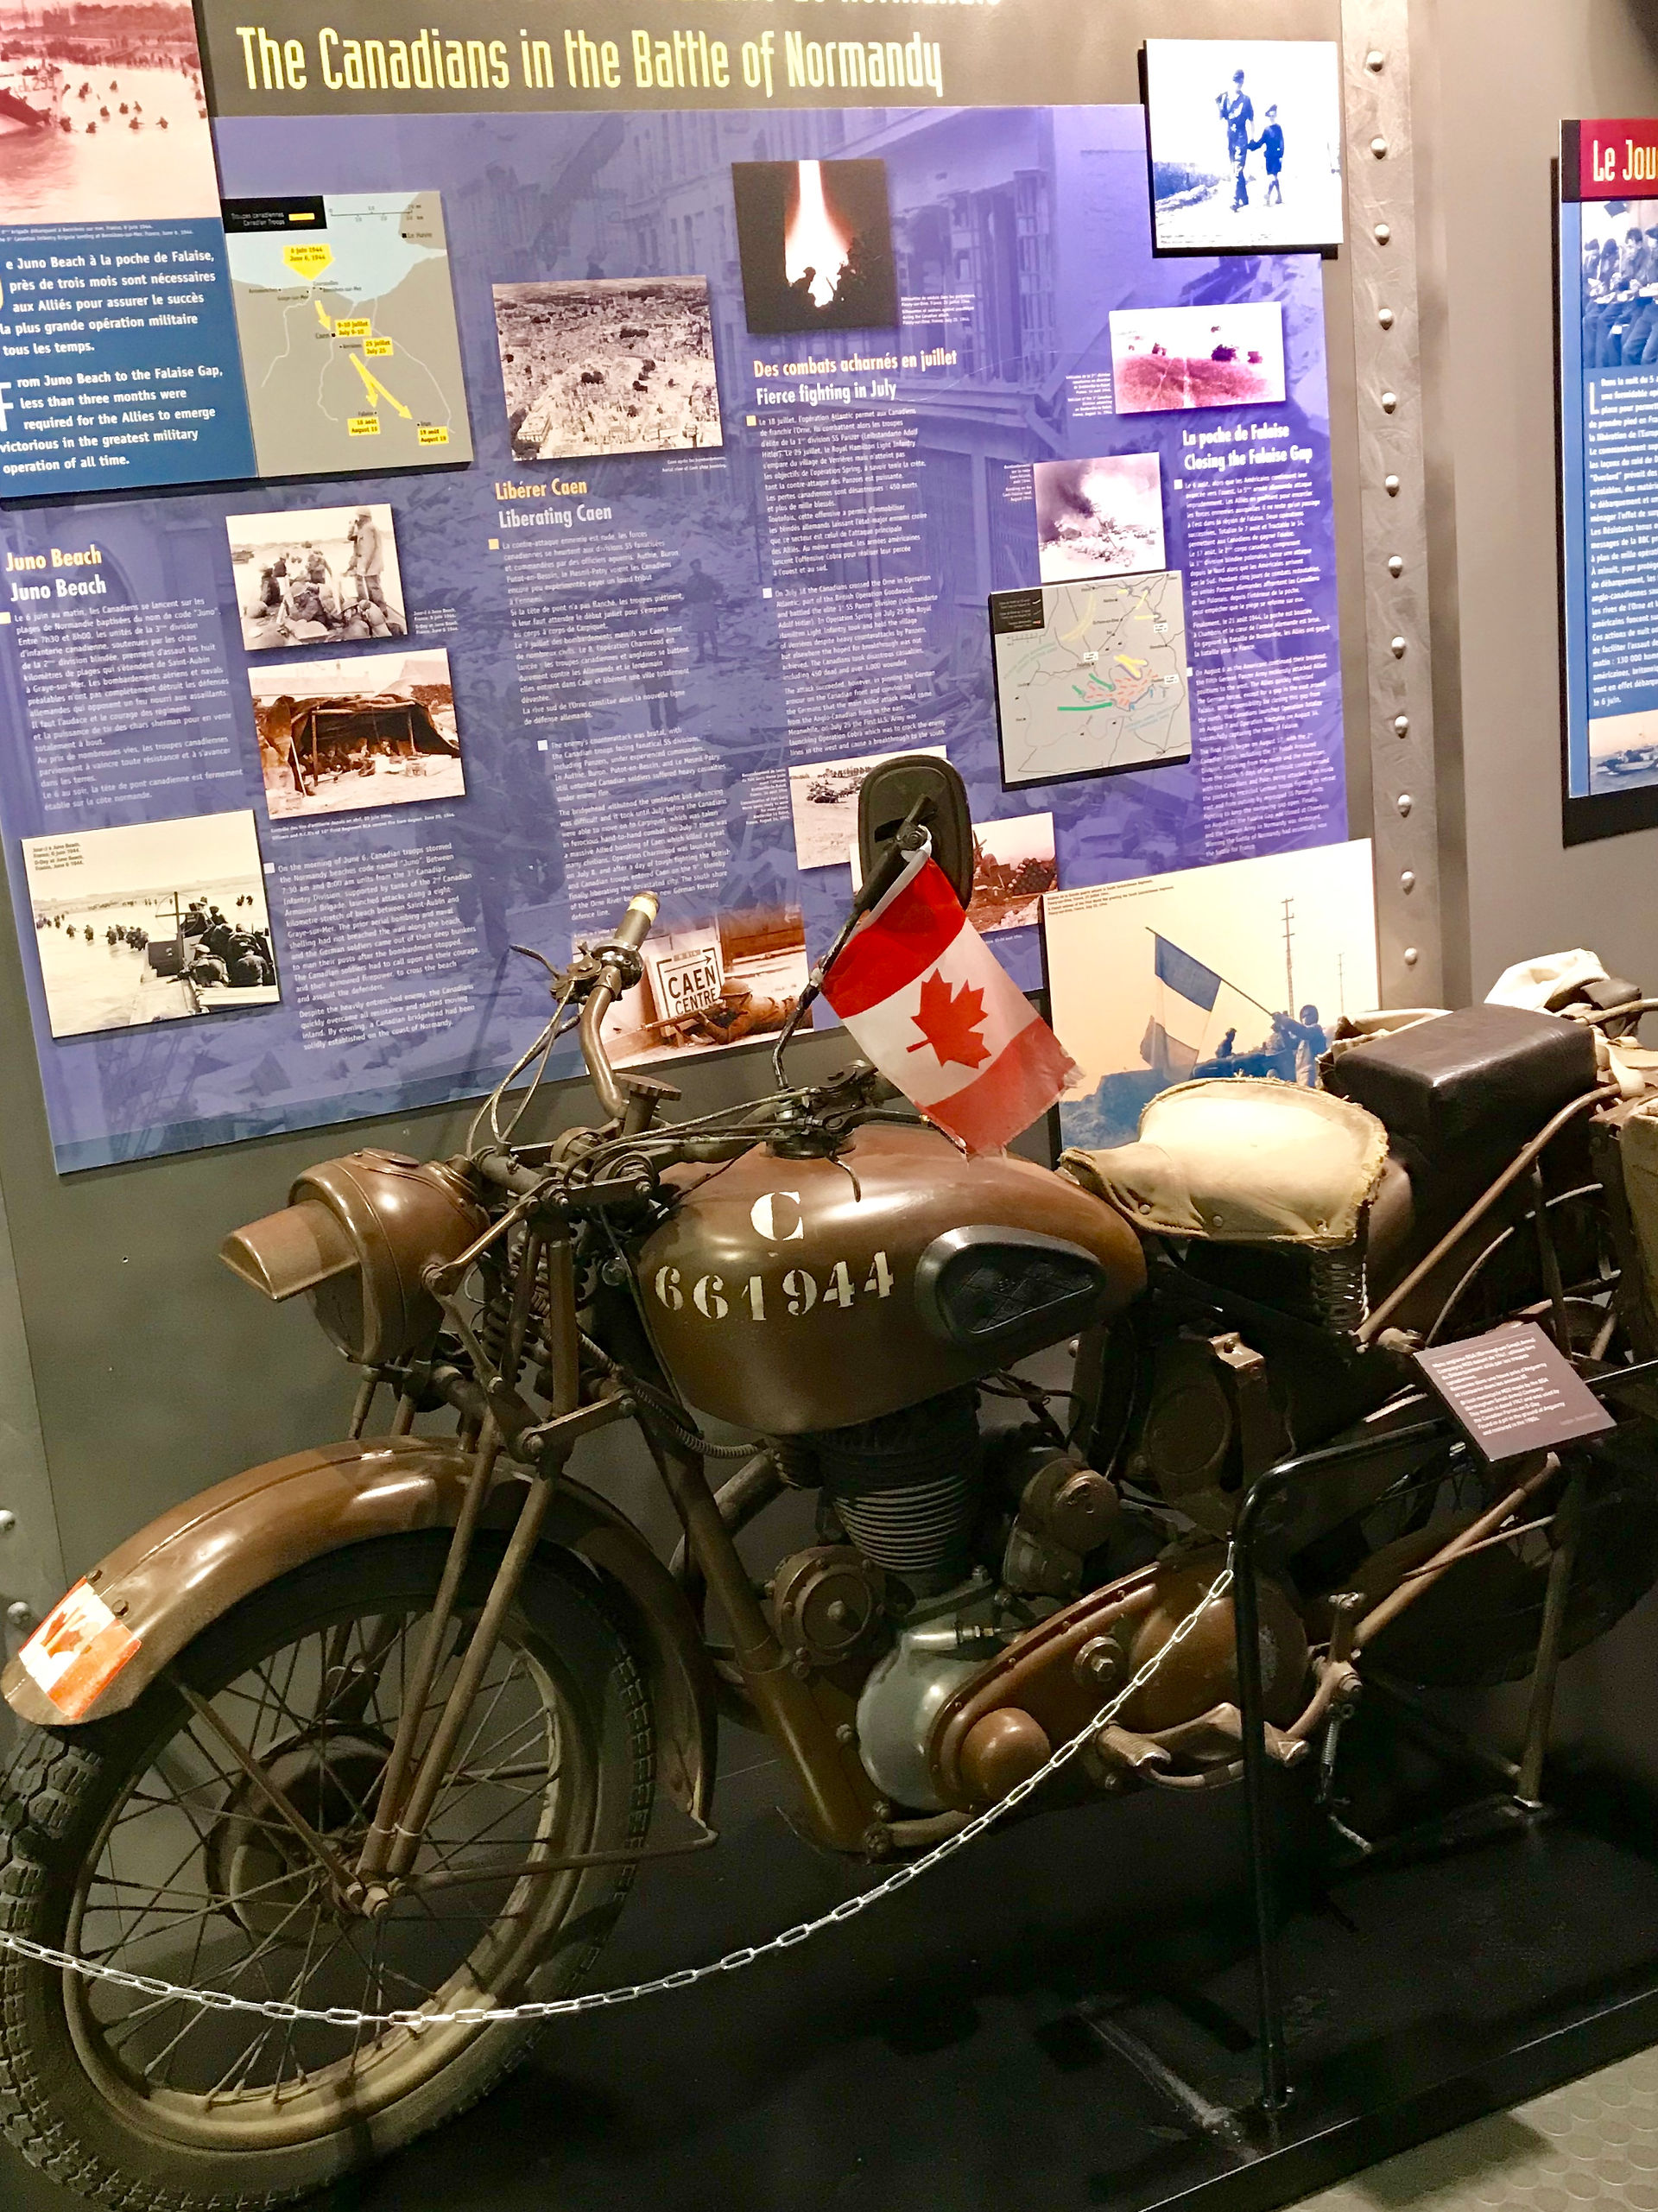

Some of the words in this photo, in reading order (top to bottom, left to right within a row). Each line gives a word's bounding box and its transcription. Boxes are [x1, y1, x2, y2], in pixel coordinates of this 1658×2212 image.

[236, 26, 307, 91] The
[320, 29, 508, 88] Canadians
[521, 29, 553, 87] in
[565, 29, 619, 87] the
[632, 30, 728, 87] Battle
[742, 30, 774, 98] of
[785, 32, 941, 97] Normandy
[1593, 140, 1615, 181] Le
[16, 257, 46, 269] Juno
[50, 255, 85, 267] Beach
[89, 254, 97, 266] à
[99, 254, 111, 265] la
[115, 252, 149, 267] poche
[154, 251, 168, 263] de
[171, 250, 213, 262] Falaise,
[9, 279, 35, 294] près
[39, 278, 54, 289] de
[57, 276, 85, 288] trois
[89, 275, 117, 287] mois
[121, 274, 146, 285] sont
[150, 271, 215, 283] nécessaires
[12, 303, 33, 312] aux
[38, 298, 71, 310] Alliés
[75, 299, 101, 311] pour
[106, 297, 147, 307] assurer
[151, 294, 163, 305] le
[168, 292, 203, 304] succès
[0, 323, 11, 334] la
[15, 322, 41, 336] plus
[44, 320, 84, 334] grande
[88, 317, 144, 331] opération
[149, 314, 197, 326] militaire
[3, 345, 28, 356] tous
[33, 342, 50, 354] les
[54, 342, 95, 353] temps.
[753, 360, 778, 377] Des
[783, 356, 835, 375] combats
[839, 352, 896, 371] acharnés
[901, 355, 916, 368] en
[921, 347, 956, 371] juillet
[16, 377, 40, 387] rom
[43, 375, 73, 386] Juno
[76, 371, 111, 383] Beach
[114, 371, 127, 381] to
[130, 369, 150, 380] the
[155, 366, 193, 378] Falaise
[197, 364, 224, 377] Gap,
[20, 397, 43, 409] less
[47, 396, 74, 407] than
[78, 393, 109, 404] three
[113, 390, 155, 402] months
[160, 390, 187, 399] were
[756, 386, 796, 406] Fierce
[799, 382, 851, 407] fighting
[853, 381, 867, 398] in
[870, 377, 897, 401] July
[23, 415, 73, 430] required
[77, 415, 93, 426] for
[98, 413, 117, 424] the
[122, 410, 154, 422] Allies
[158, 409, 170, 420] to
[174, 409, 215, 419] emerge
[0, 439, 58, 452] victorious
[62, 436, 74, 447] in
[78, 435, 98, 447] the
[102, 432, 149, 447] greatest
[153, 428, 198, 440] military
[1182, 429, 1196, 447] La
[1199, 426, 1231, 448] poche
[1234, 424, 1247, 440] de
[1250, 422, 1288, 440] Falaise
[3, 460, 60, 475] operation
[63, 456, 76, 469] of
[79, 455, 95, 467] all
[98, 454, 129, 466] time.
[1184, 453, 1225, 472] Closing
[1228, 449, 1245, 467] the
[1249, 447, 1287, 464] Falaise
[1289, 445, 1312, 463] Gap
[495, 480, 546, 499] Libérer
[551, 478, 586, 495] Caen
[498, 508, 572, 528] Liberating
[576, 504, 611, 521] Caen
[5, 552, 46, 571] Juno
[51, 544, 101, 567] Beach
[10, 582, 50, 601] Juno
[55, 574, 106, 597] Beach
[32, 612, 48, 622] juin
[62, 607, 87, 618] matin,
[102, 604, 138, 613] Canadiens
[151, 600, 178, 609] lancent
[529, 638, 549, 649] juillet
[614, 630, 636, 640] massifs
[649, 625, 664, 634] Caen
[303, 859, 332, 868] morning
[333, 856, 341, 865] of
[343, 855, 359, 864] June
[361, 853, 369, 863] 6,
[370, 850, 400, 859] Canadian
[402, 846, 423, 855] troops
[425, 842, 452, 852] stormed
[668, 965, 717, 999] CAEN
[675, 987, 718, 1016] CENTRE
[750, 1192, 803, 1240] C
[655, 1251, 895, 1321] 661944
